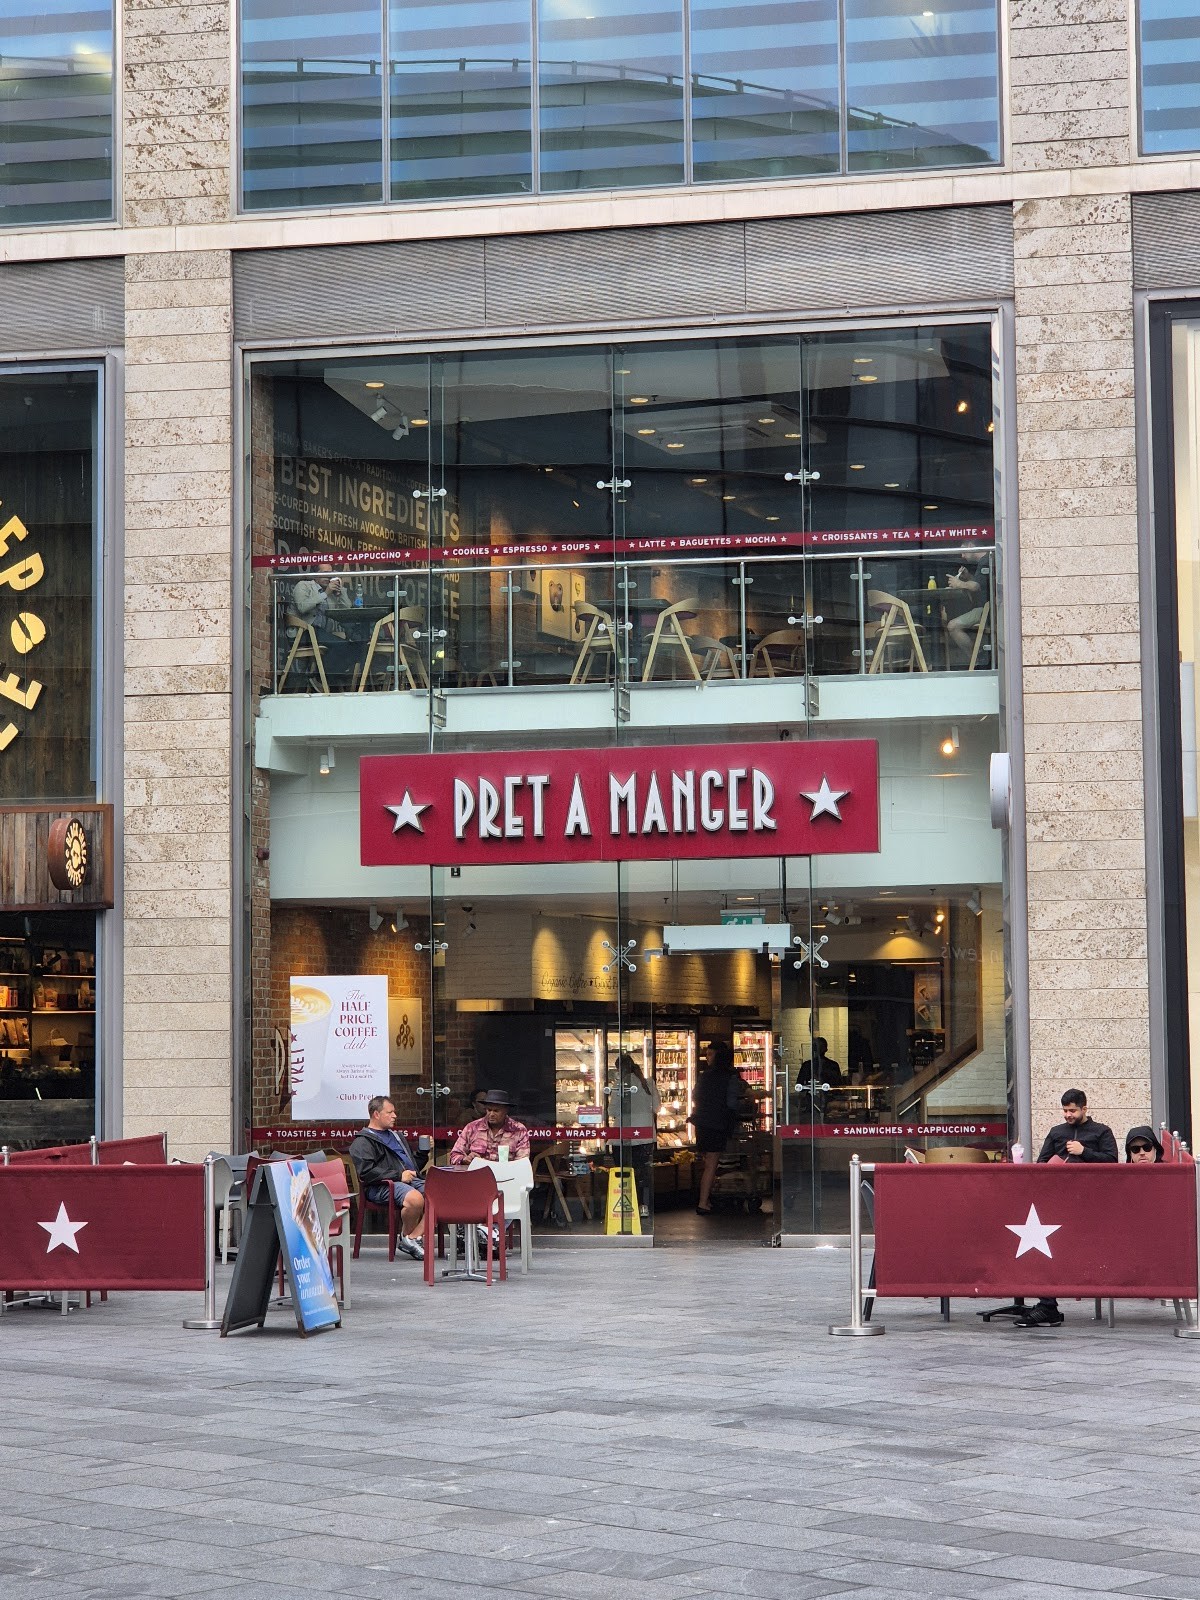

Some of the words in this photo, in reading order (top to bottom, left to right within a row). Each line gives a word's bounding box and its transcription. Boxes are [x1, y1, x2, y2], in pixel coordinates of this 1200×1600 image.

[281, 453, 332, 498] BEST
[339, 473, 460, 542] INGREDIENTS
[273, 513, 315, 540] SCOTTISH
[317, 527, 356, 552] SALMON,
[310, 503, 331, 523] HAM,
[333, 510, 359, 531] FRESH
[360, 520, 396, 545] AVOCADO,
[398, 532, 427, 549] BRITISH
[822, 532, 878, 541] CROISSANTS
[924, 530, 946, 538] FLAT
[949, 528, 977, 537] WHITE
[638, 540, 667, 548] LATTE
[679, 537, 732, 546] BAGUETTES
[744, 535, 777, 544] MOCHA
[452, 547, 490, 556] COOKIES
[502, 545, 548, 554] ESPRESSO
[561, 543, 591, 551] SOUPS
[279, 554, 334, 564] SANDWICHES
[346, 551, 401, 560] CAPPUCCINO
[453, 774, 550, 840] PRET
[564, 773, 593, 837] A
[608, 767, 778, 837] MANGER
[345, 989, 365, 1000] The
[341, 1001, 371, 1011] HALF
[340, 1014, 373, 1024] PRICE
[335, 1026, 378, 1037] COFFEE
[343, 1036, 367, 1050] club
[339, 1093, 357, 1101] Club
[276, 1130, 317, 1138] TOASTIES
[566, 1129, 597, 1137] WRAPS
[843, 1126, 903, 1135] SANDWICHES
[917, 1126, 976, 1134] CAPPUCCINO
[293, 1255, 311, 1271] Order
[297, 1272, 311, 1289] your
